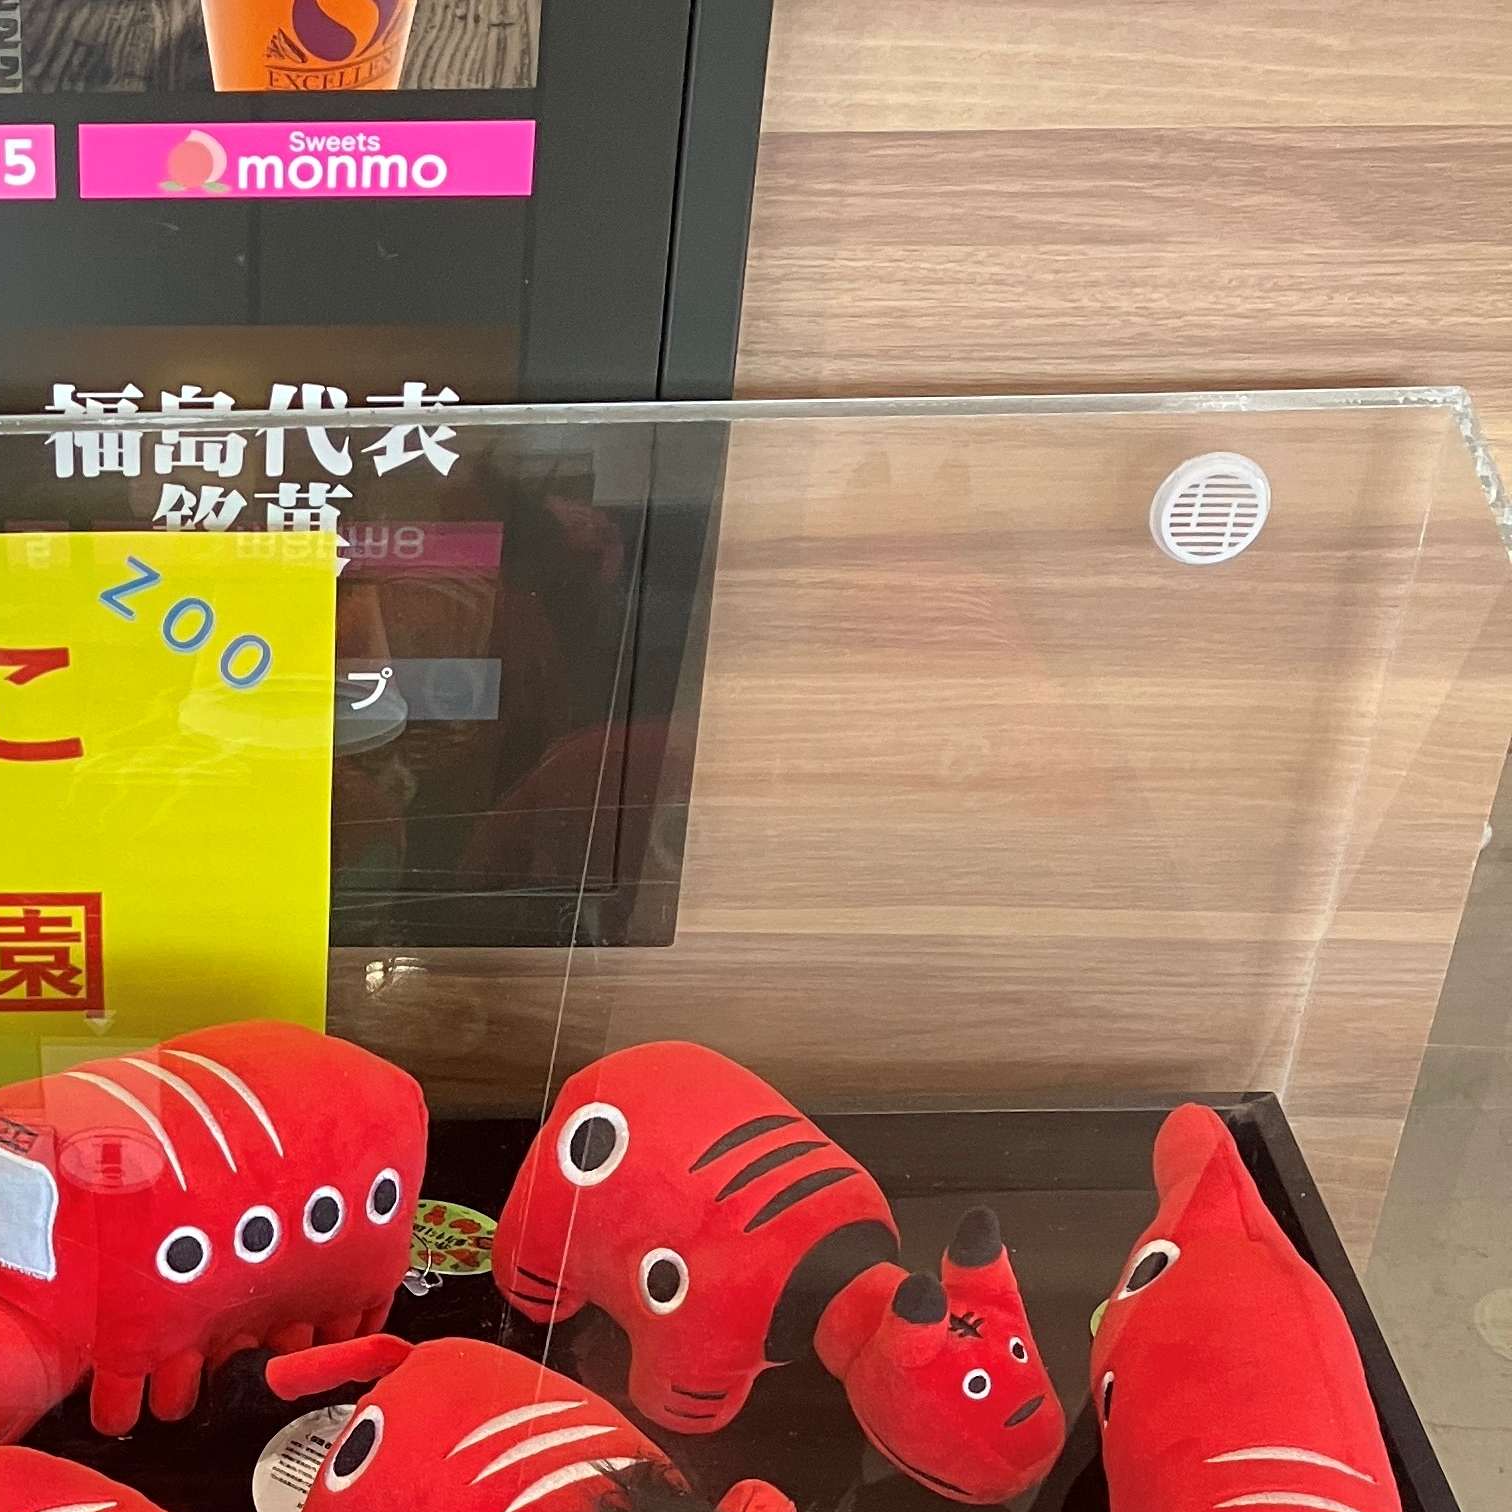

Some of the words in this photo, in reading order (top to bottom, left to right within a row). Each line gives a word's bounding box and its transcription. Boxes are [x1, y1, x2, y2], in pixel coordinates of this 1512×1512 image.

[3, 138, 37, 186] 5
[289, 131, 381, 153] Sweets
[237, 152, 448, 190] monmo
[45, 381, 461, 478] 福島代表
[99, 554, 273, 690] ZOO
